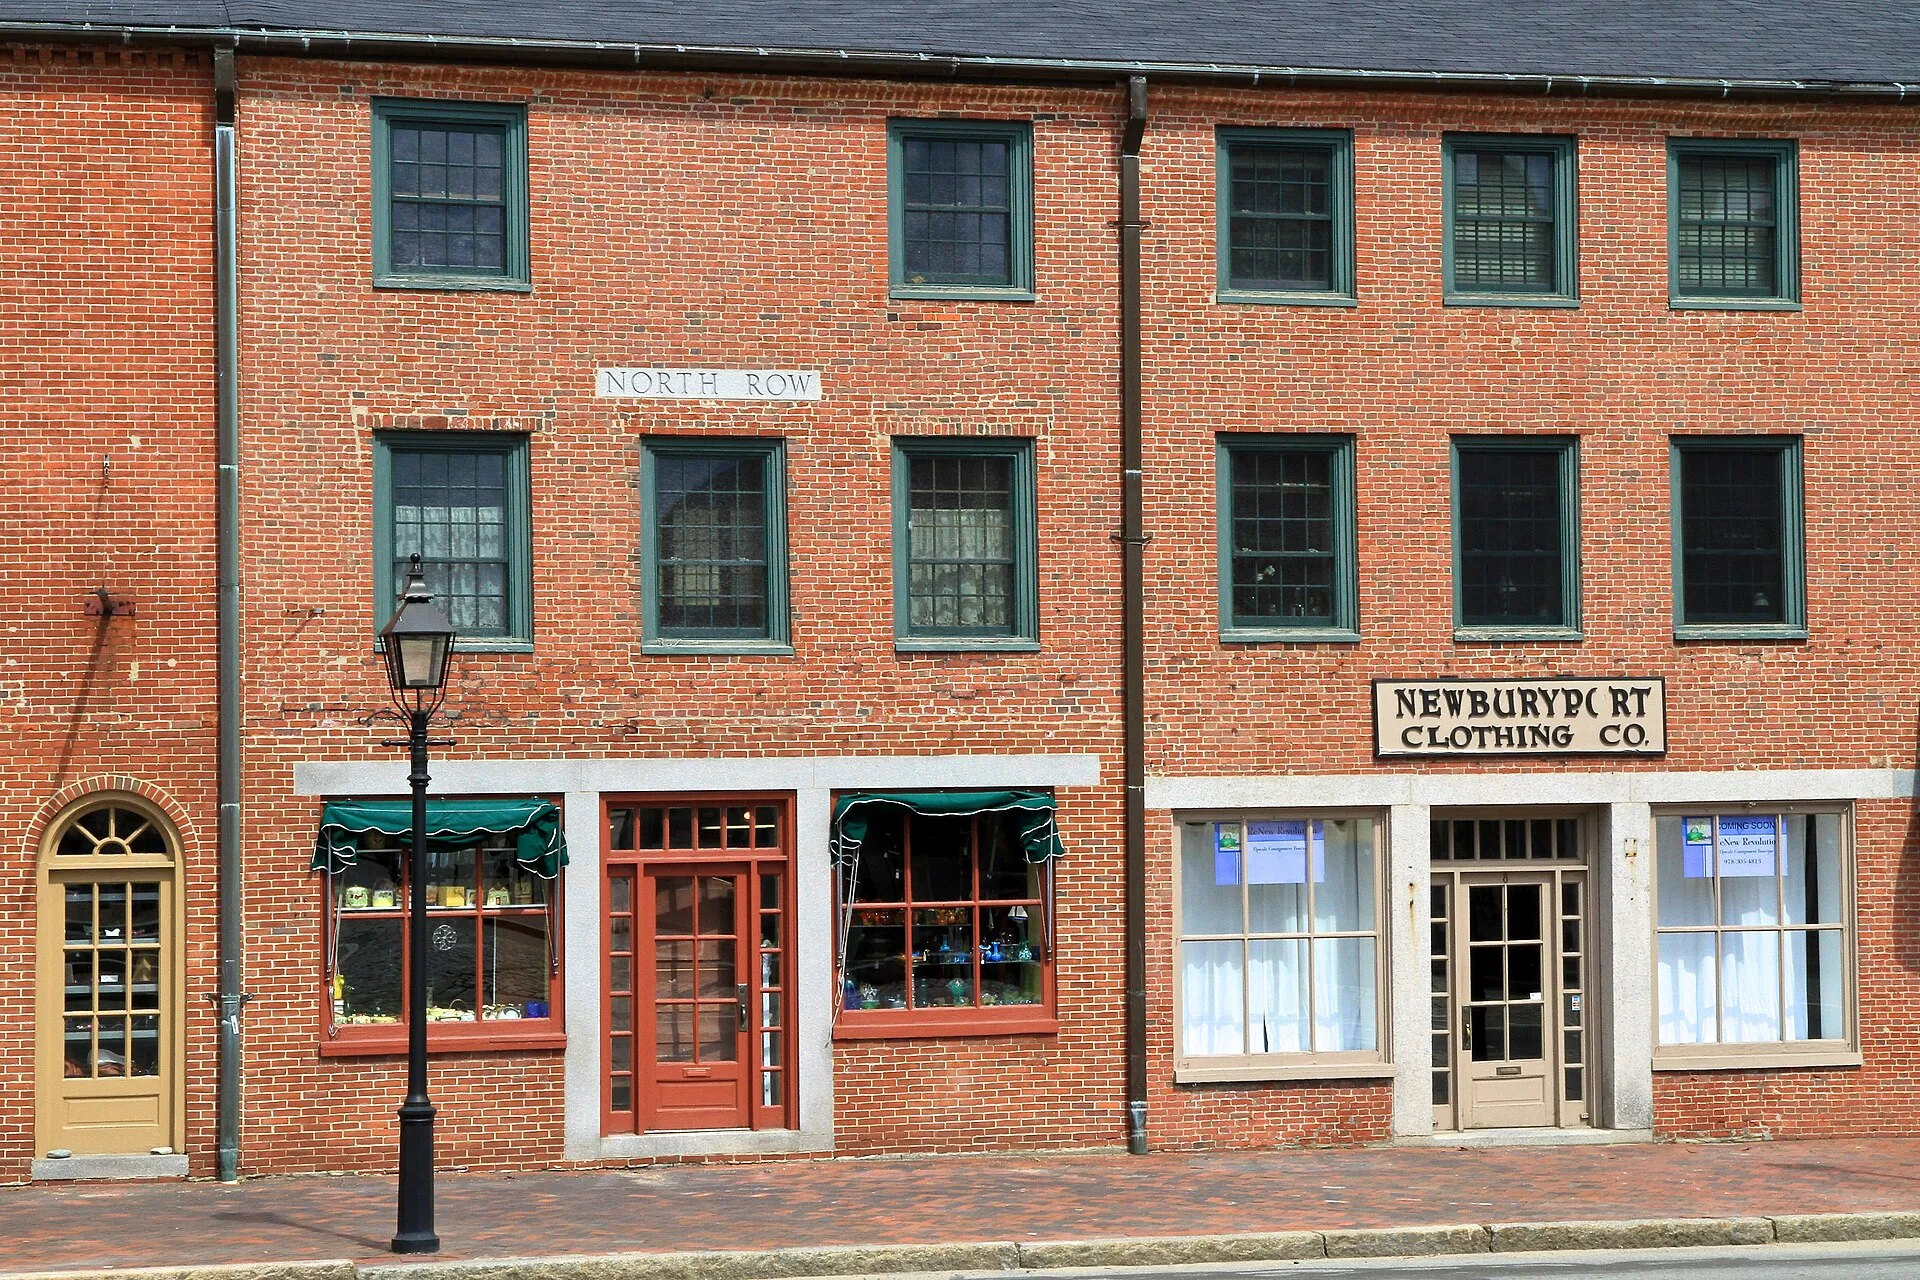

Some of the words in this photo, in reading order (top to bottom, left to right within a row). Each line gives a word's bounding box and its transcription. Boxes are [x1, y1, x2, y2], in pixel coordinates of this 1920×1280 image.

[606, 371, 718, 396] NORTH
[745, 373, 812, 396] ROW
[1401, 723, 1574, 748] CLOTHING
[1599, 723, 1650, 747] CO.
[1751, 821, 1776, 830] SOON
[1719, 838, 1739, 846] eNew
[1742, 837, 1776, 846] Revolutio
